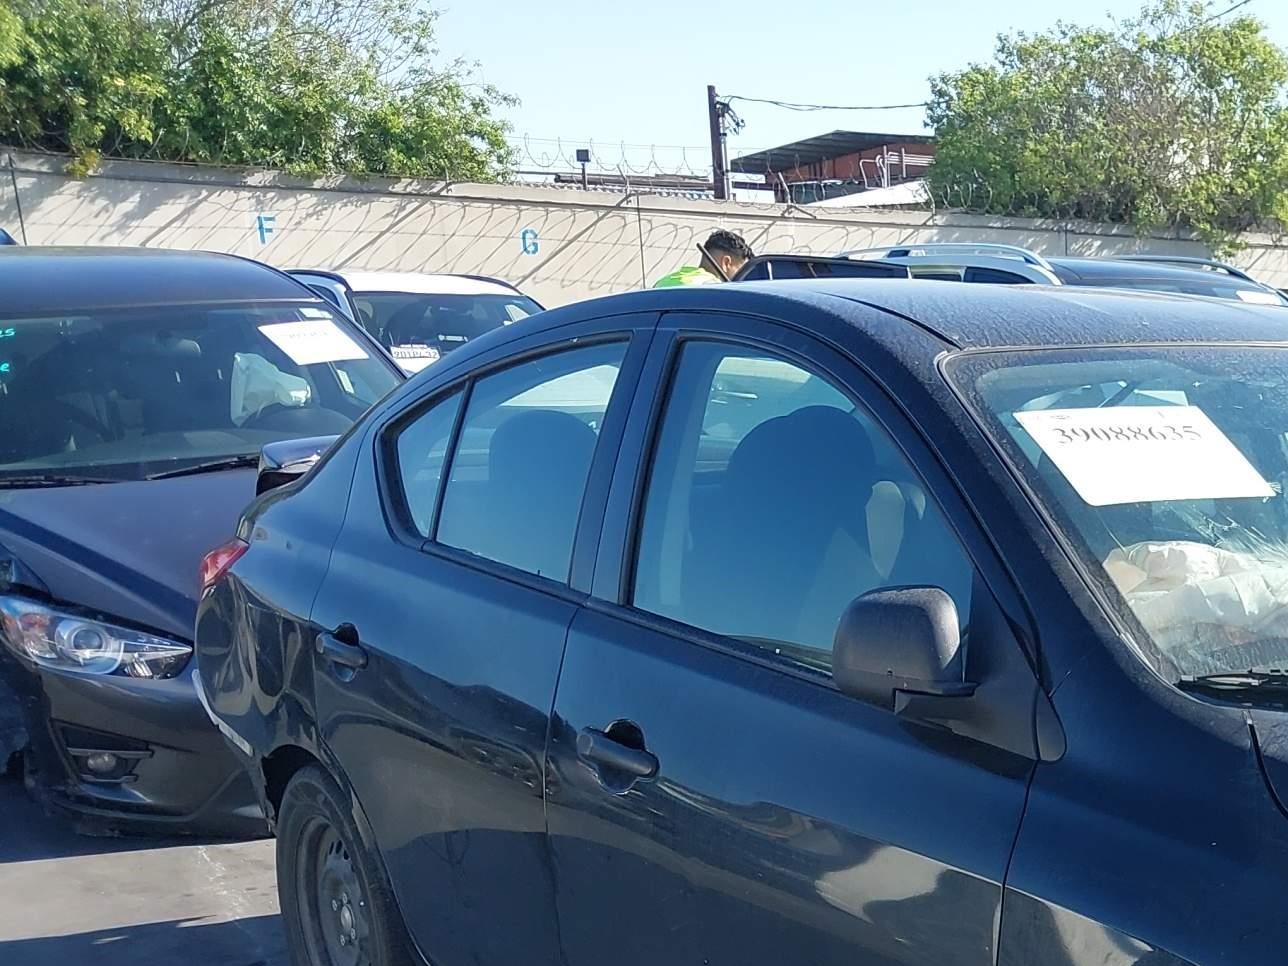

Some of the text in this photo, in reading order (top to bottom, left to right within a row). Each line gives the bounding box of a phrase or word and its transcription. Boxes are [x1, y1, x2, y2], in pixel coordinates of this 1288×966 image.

[256, 215, 276, 245] F
[520, 228, 539, 255] G
[1052, 425, 1202, 444] 39088635
